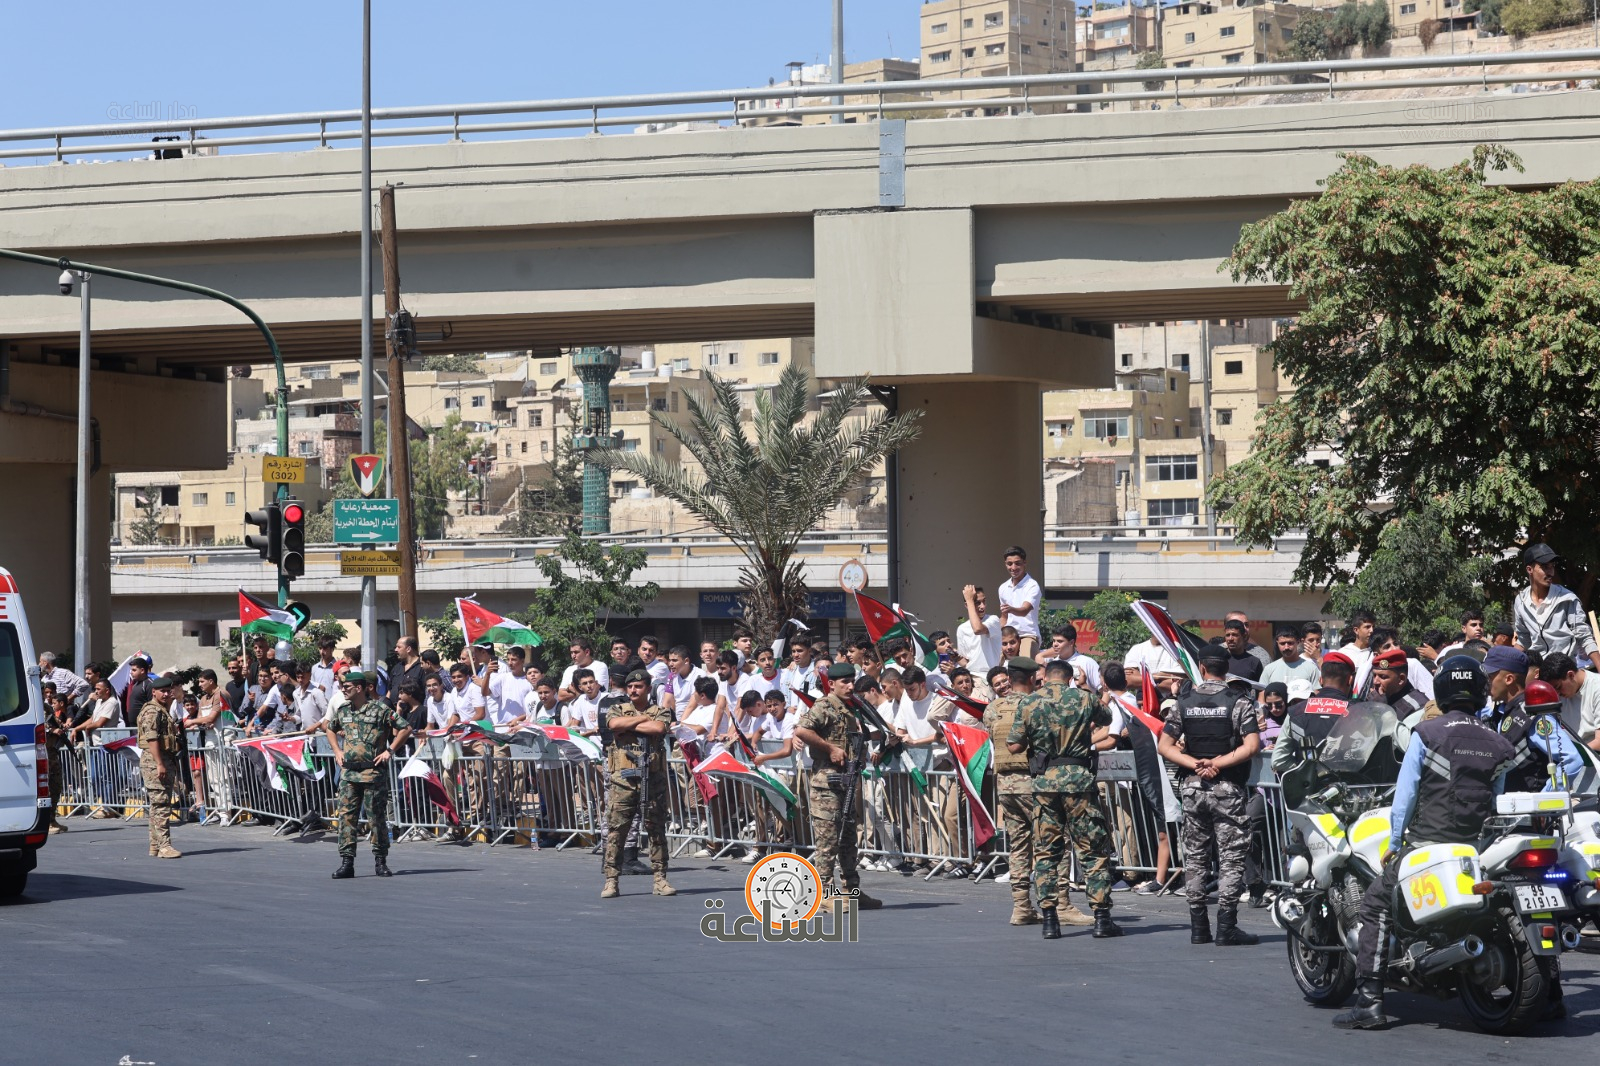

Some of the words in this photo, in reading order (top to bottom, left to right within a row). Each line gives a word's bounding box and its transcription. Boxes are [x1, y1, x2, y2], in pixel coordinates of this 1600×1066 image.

[271, 471, 297, 481] (302)
[340, 501, 361, 513] رعاية
[360, 501, 391, 513] جمعية
[334, 516, 358, 529] الخيرية
[358, 516, 380, 528] المحطة
[703, 594, 731, 603] ROMAN
[1451, 671, 1473, 680] POLICE
[1186, 707, 1227, 716] GENDARMERIE
[1443, 716, 1472, 728] السير
[1475, 750, 1493, 758] POLICE
[1410, 870, 1437, 910] 35
[1530, 885, 1545, 897] 99
[1524, 896, 1559, 910] 21913
